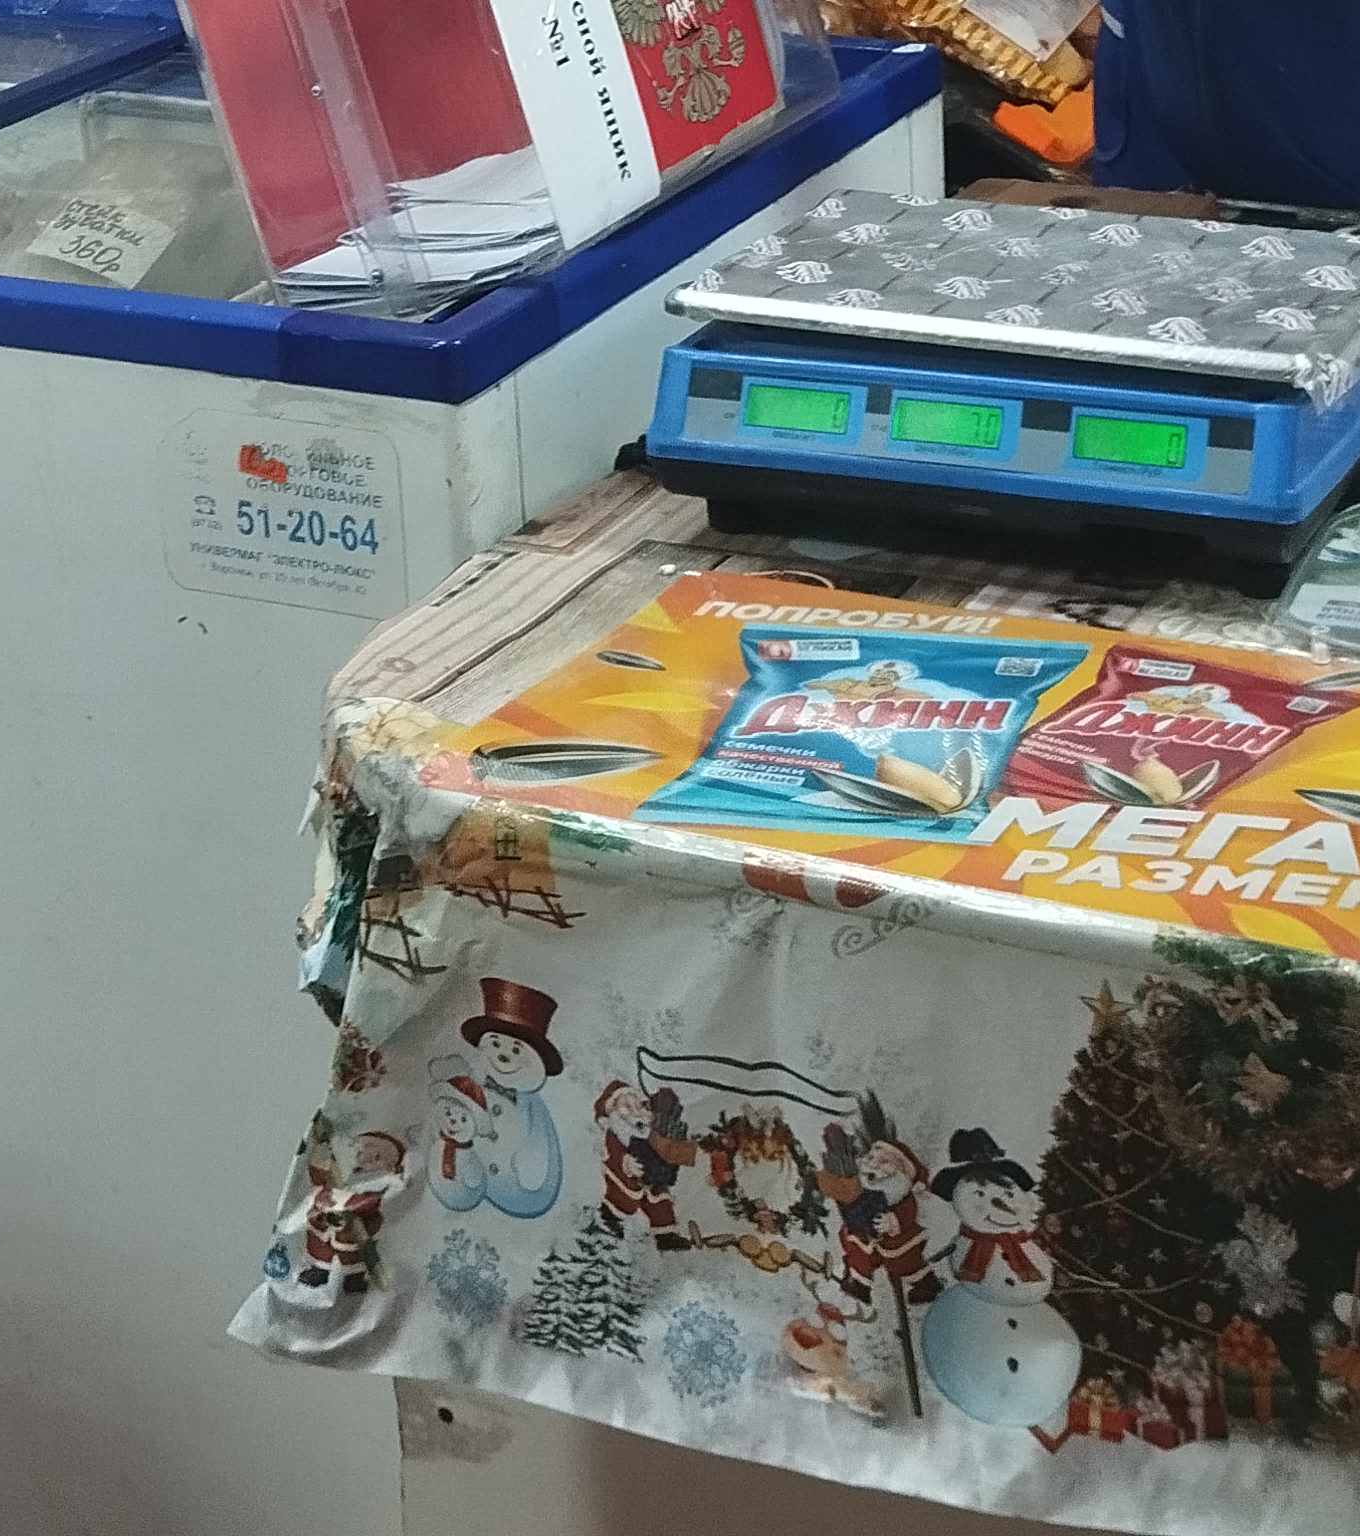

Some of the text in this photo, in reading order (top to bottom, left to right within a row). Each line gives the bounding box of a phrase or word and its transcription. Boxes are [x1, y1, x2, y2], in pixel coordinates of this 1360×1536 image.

[541, 14, 571, 69] №1
[597, 86, 632, 182] ящик
[1167, 431, 1183, 465] 0
[245, 477, 384, 509] ОБОРУДОВАНИЕ
[237, 499, 379, 555] 51-20-64
[693, 601, 1001, 635] ПОПРОБУЙ!
